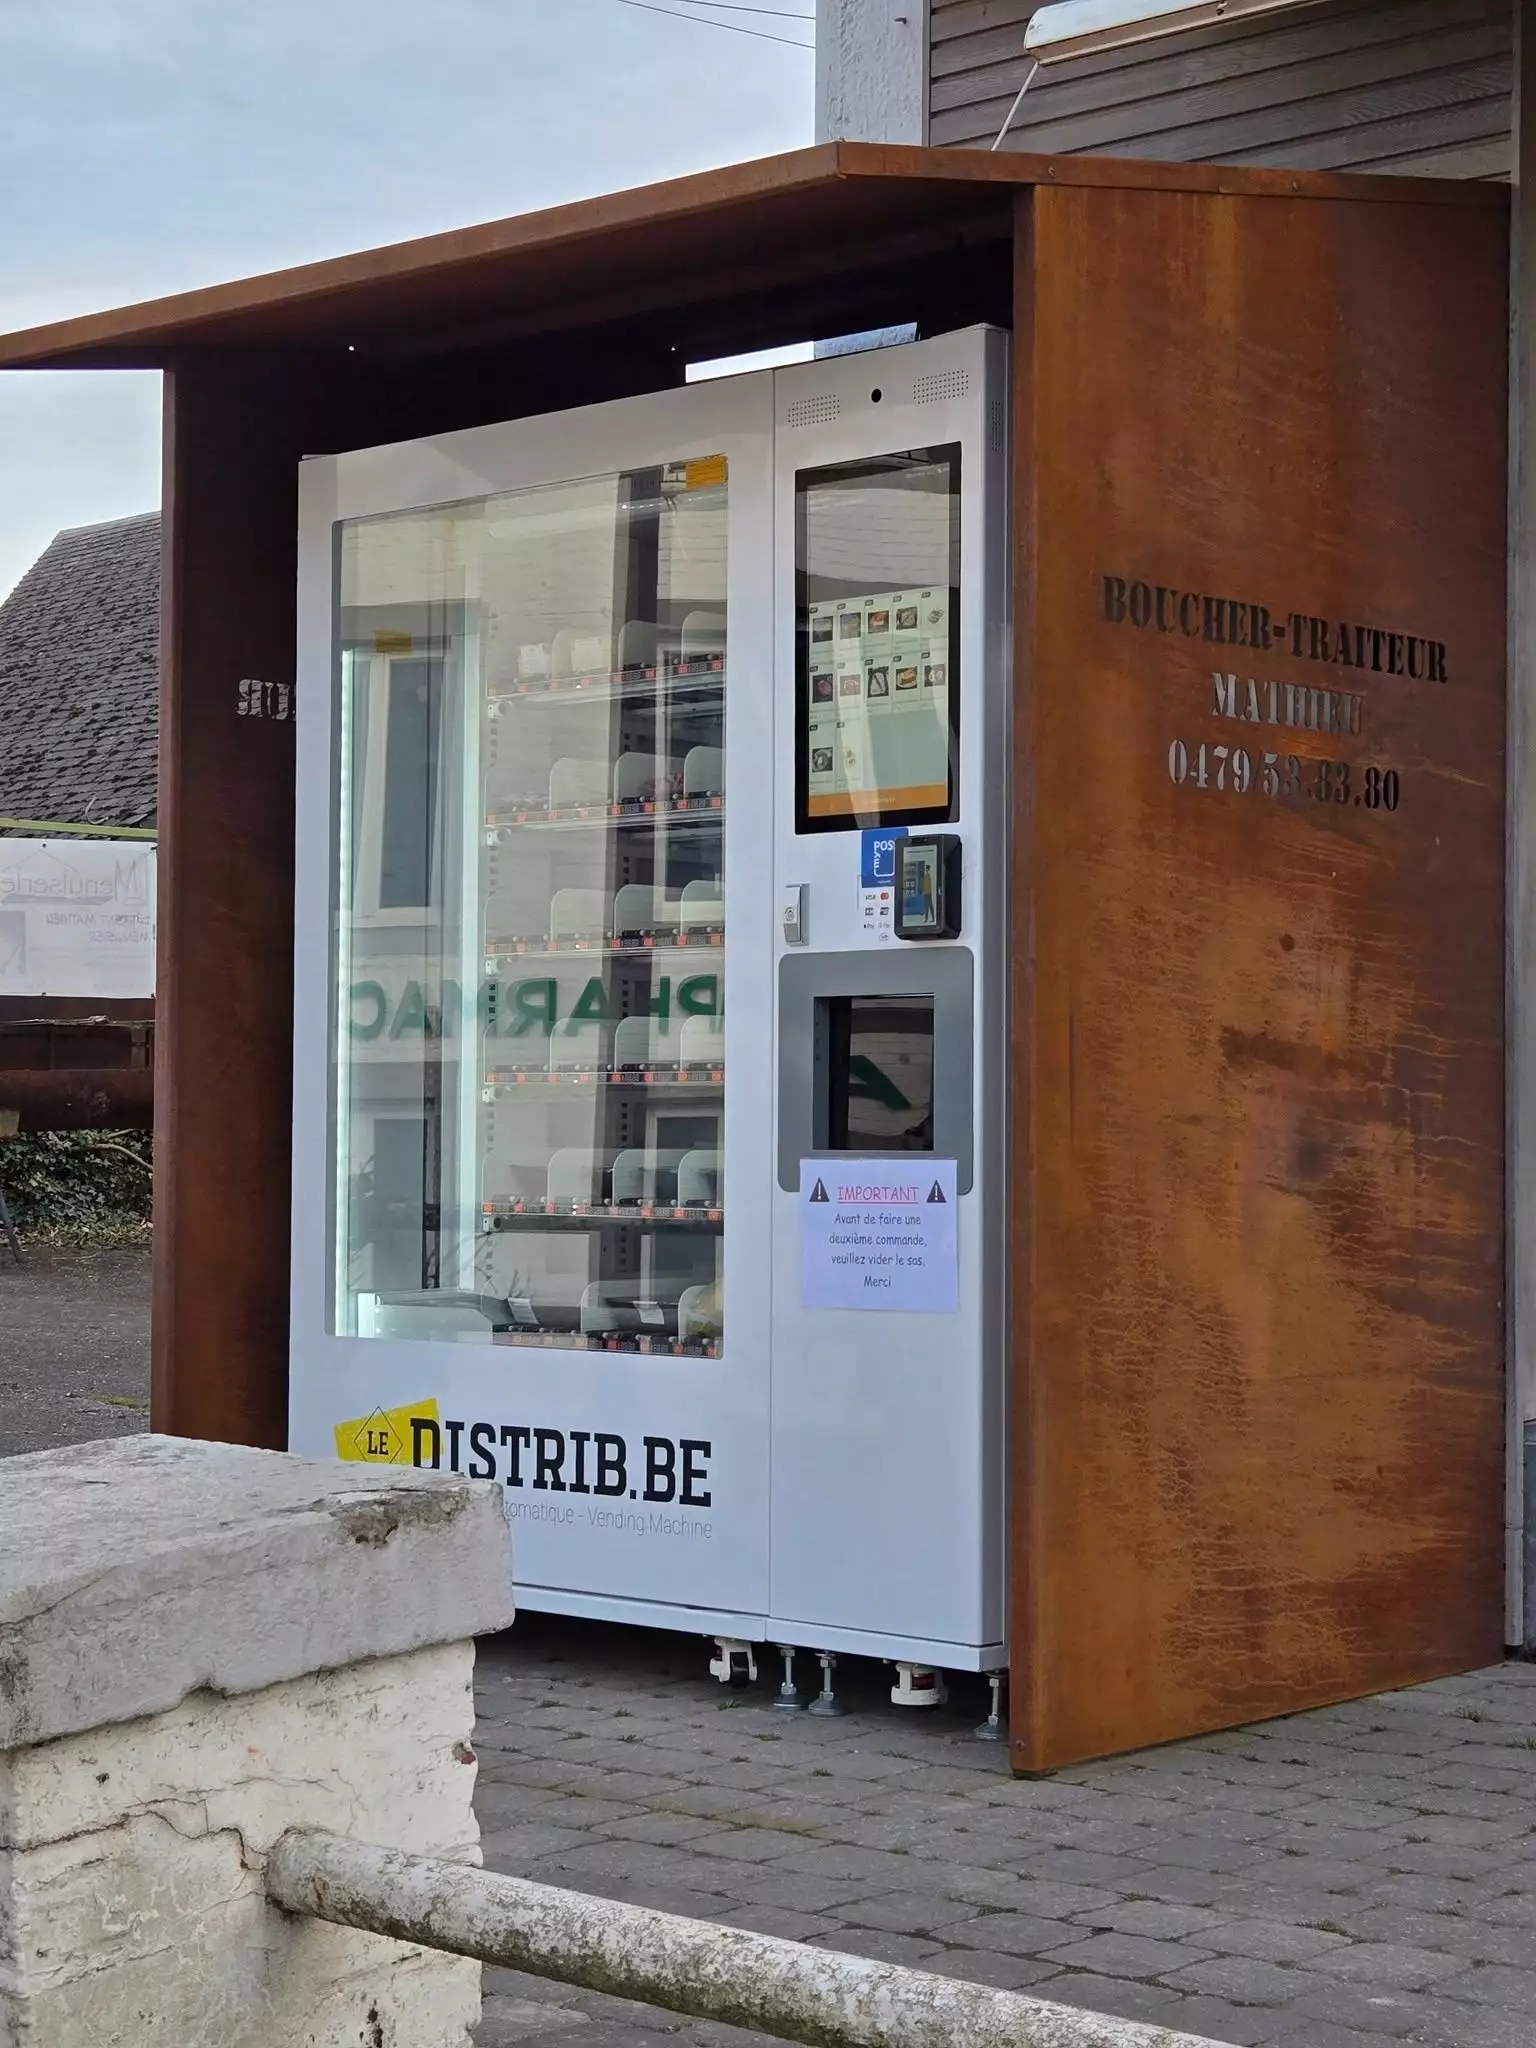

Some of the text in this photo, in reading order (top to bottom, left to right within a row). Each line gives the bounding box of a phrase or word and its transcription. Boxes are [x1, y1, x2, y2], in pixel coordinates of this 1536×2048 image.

[1102, 575, 1449, 684] BOUCHER-TRAITEUR
[1211, 671, 1366, 735] MATHIEU
[837, 1186, 919, 1201] IMPORTANT
[834, 1212, 921, 1225] Avant de faire une
[829, 1232, 928, 1248] deuxième commande,
[831, 1253, 926, 1266] veuillez vider le sas.
[864, 1275, 891, 1288] Merci
[366, 1431, 390, 1455] LE
[410, 1417, 712, 1508] DISTRIB.BE
[503, 1500, 574, 1525] tomatique
[588, 1506, 644, 1536] Vending
[649, 1513, 713, 1540] Machine
